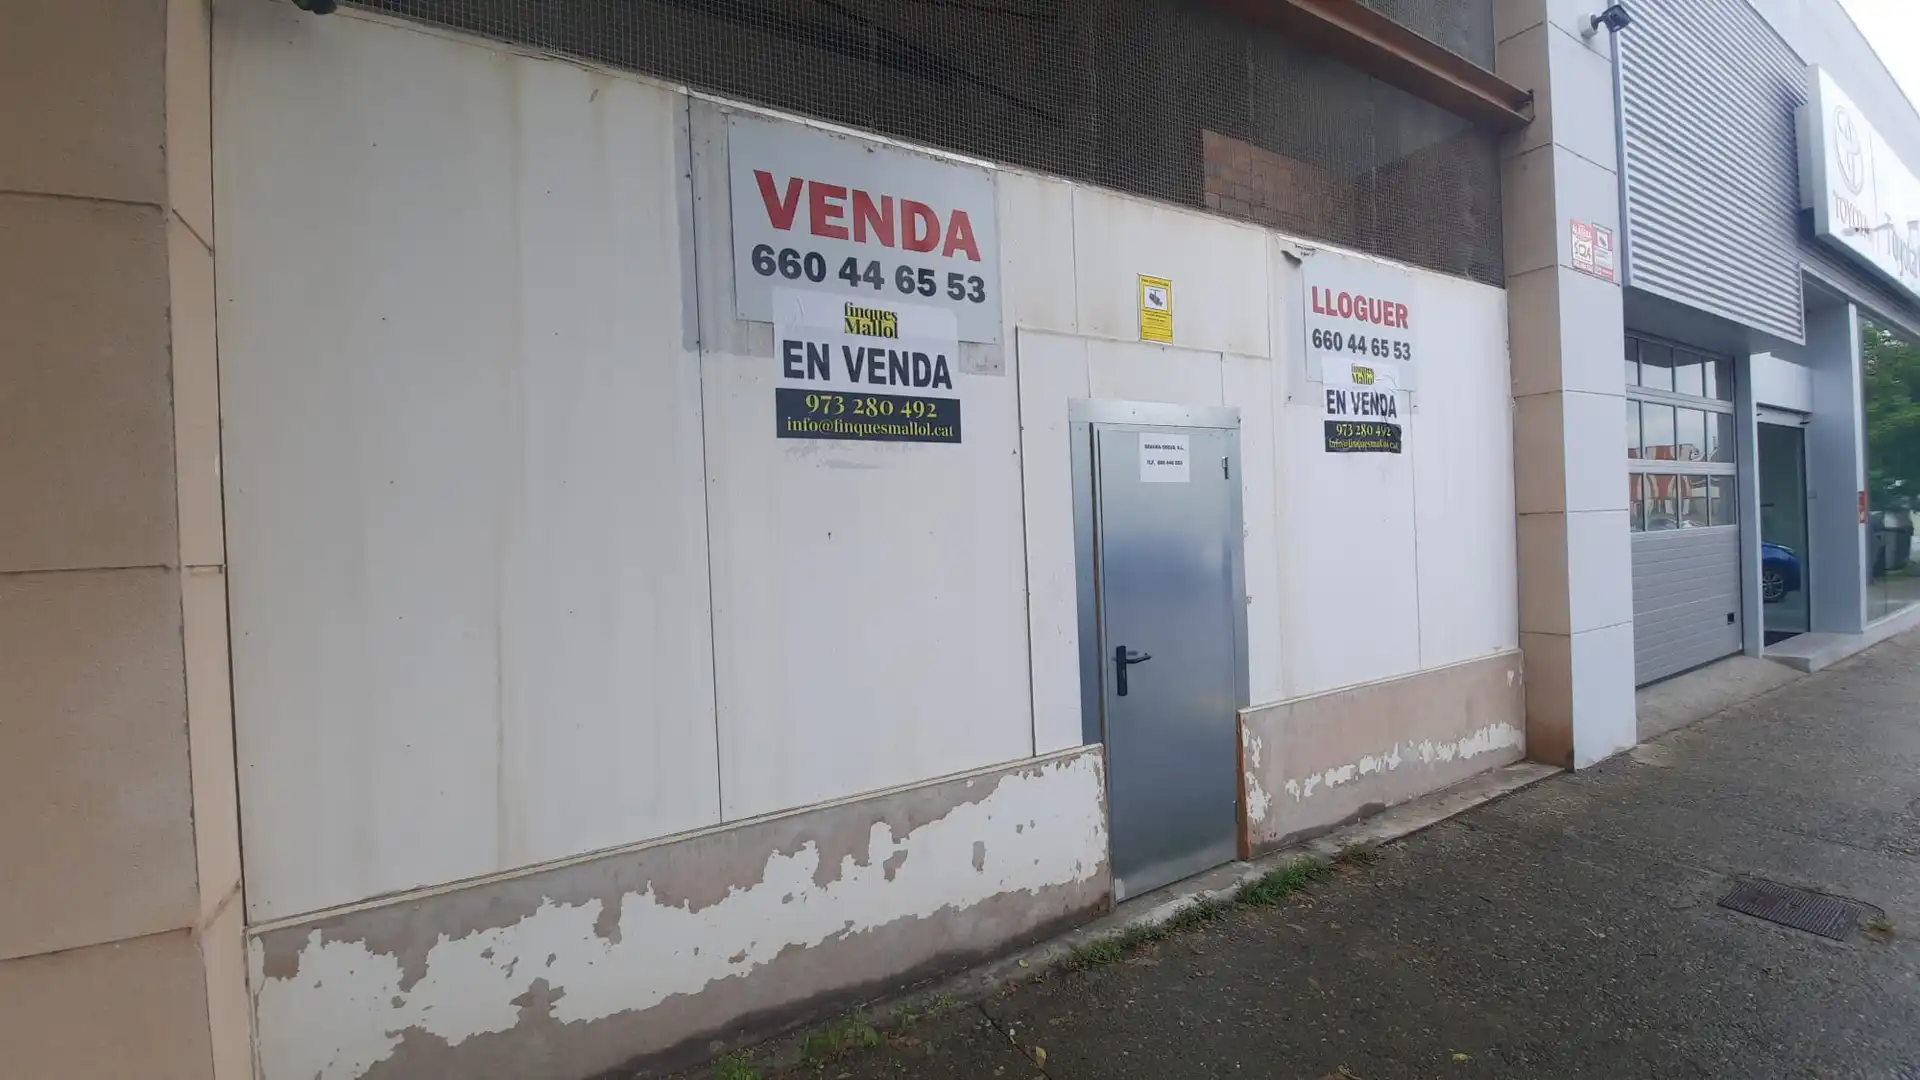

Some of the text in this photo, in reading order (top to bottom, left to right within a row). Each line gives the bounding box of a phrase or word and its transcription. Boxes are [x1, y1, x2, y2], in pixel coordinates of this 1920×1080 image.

[753, 169, 981, 262] VENDA
[751, 244, 986, 303] 660 44 65 53
[845, 301, 898, 322] finques
[1312, 286, 1409, 329] LLOGUER
[844, 317, 899, 339] Mallol
[1312, 328, 1411, 360] 660 44 65 53
[783, 339, 953, 389] EN VENDA
[805, 394, 937, 418] 973 280 492
[1326, 389, 1397, 418] EN VENDA
[787, 416, 953, 437] info@finquesmallol.cat
[1336, 424, 1391, 437] 973 280 492
